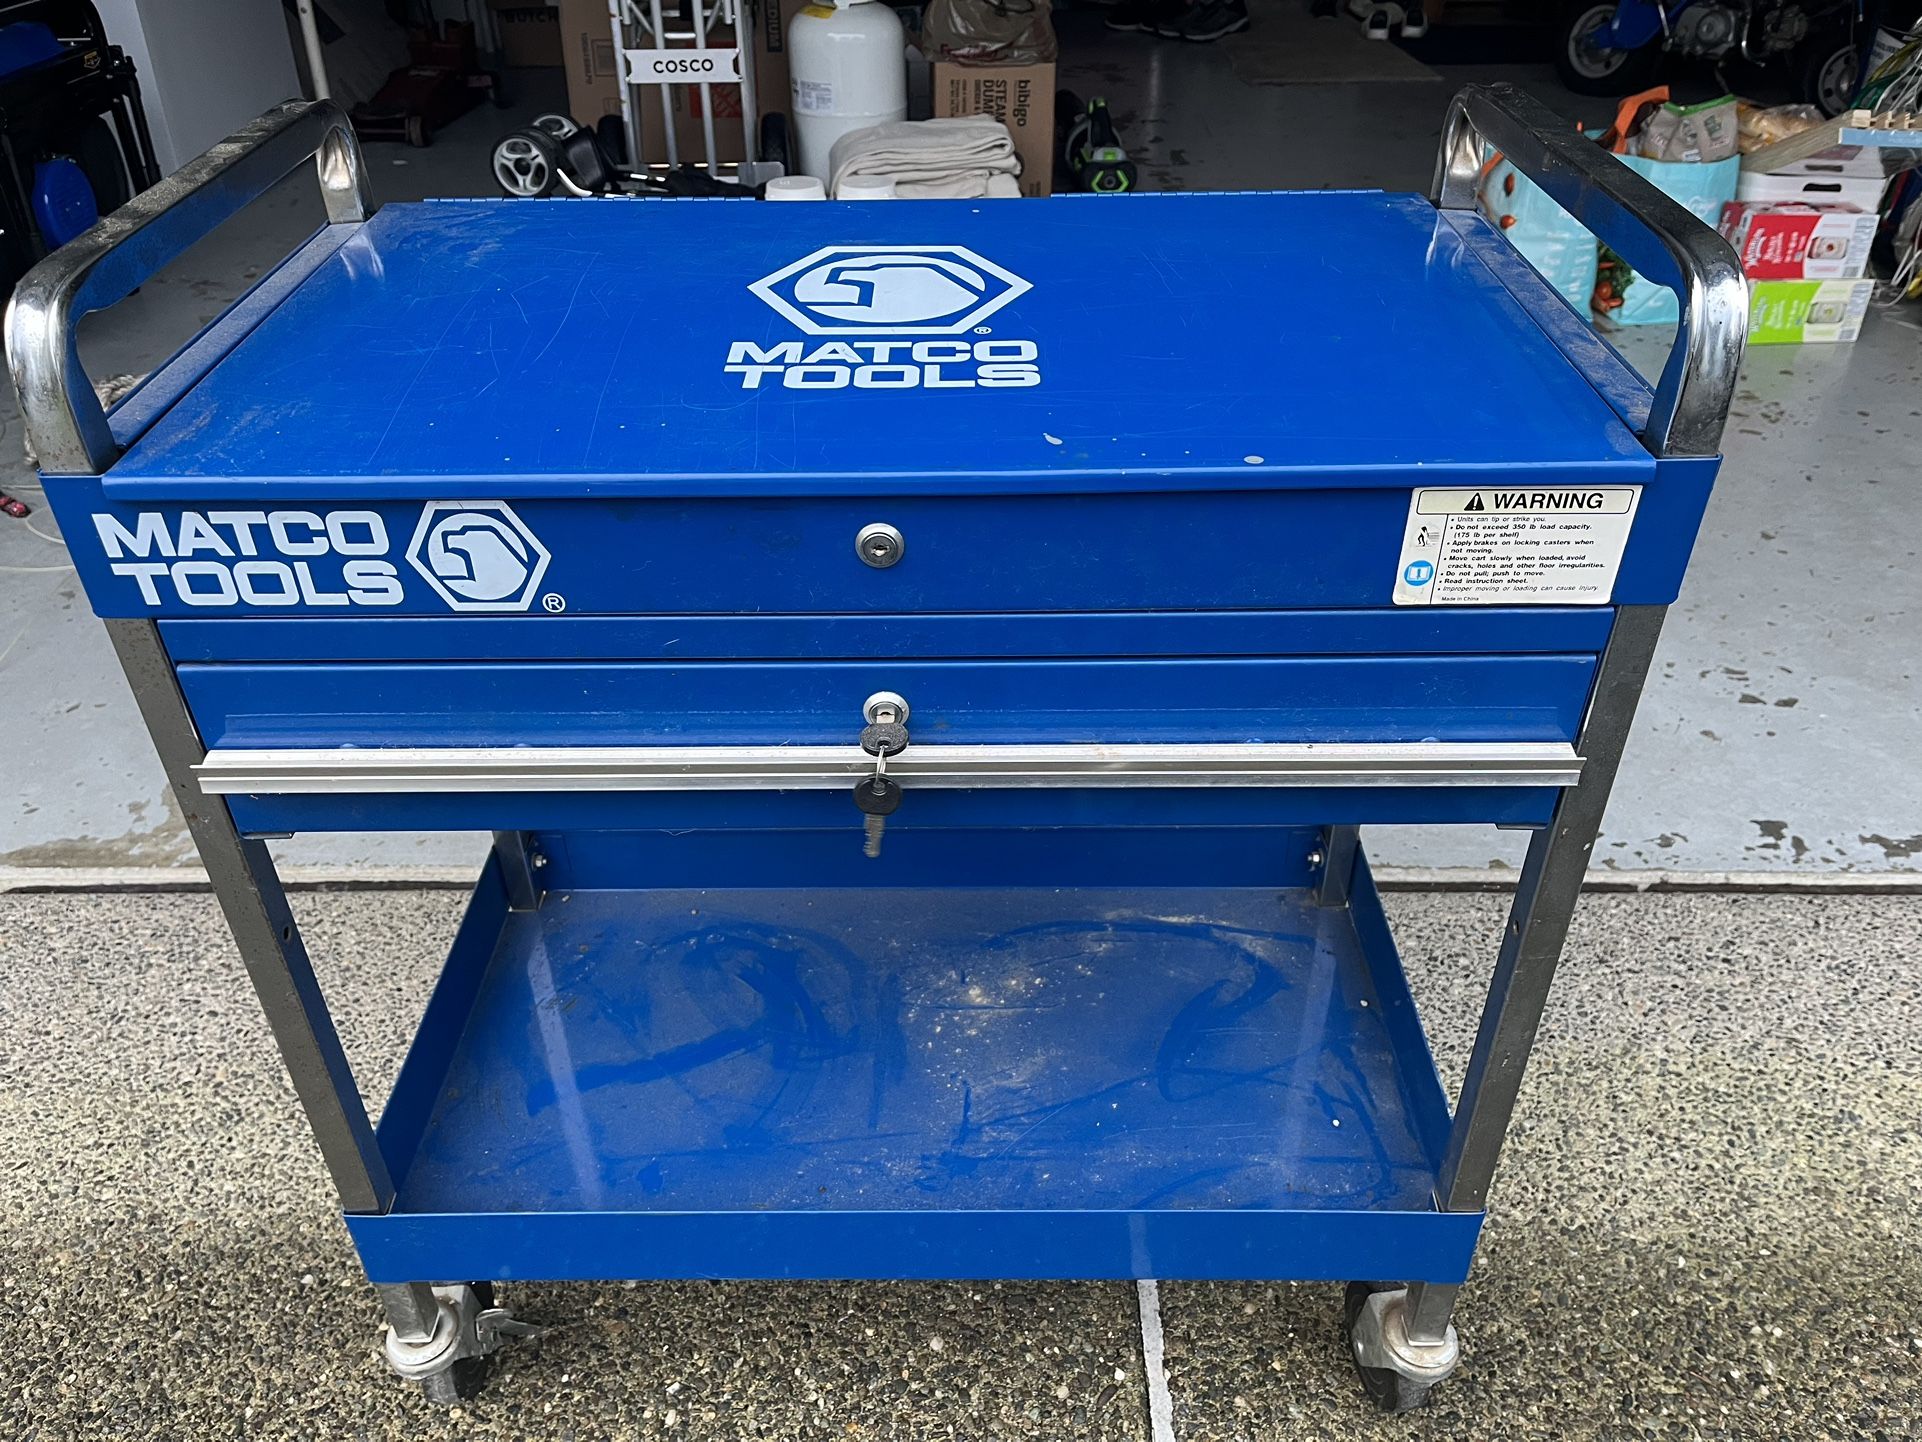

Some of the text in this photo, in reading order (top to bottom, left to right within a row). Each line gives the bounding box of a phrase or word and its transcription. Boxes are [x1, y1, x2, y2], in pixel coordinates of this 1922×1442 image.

[653, 59, 714, 73] COSCO
[1013, 79, 1031, 127] bibigo
[725, 340, 1038, 363] MATCO
[723, 364, 1041, 389] TOOLS
[1494, 492, 1604, 509] WARNING
[91, 510, 390, 558] MATCO
[110, 560, 405, 606] TOOLS
